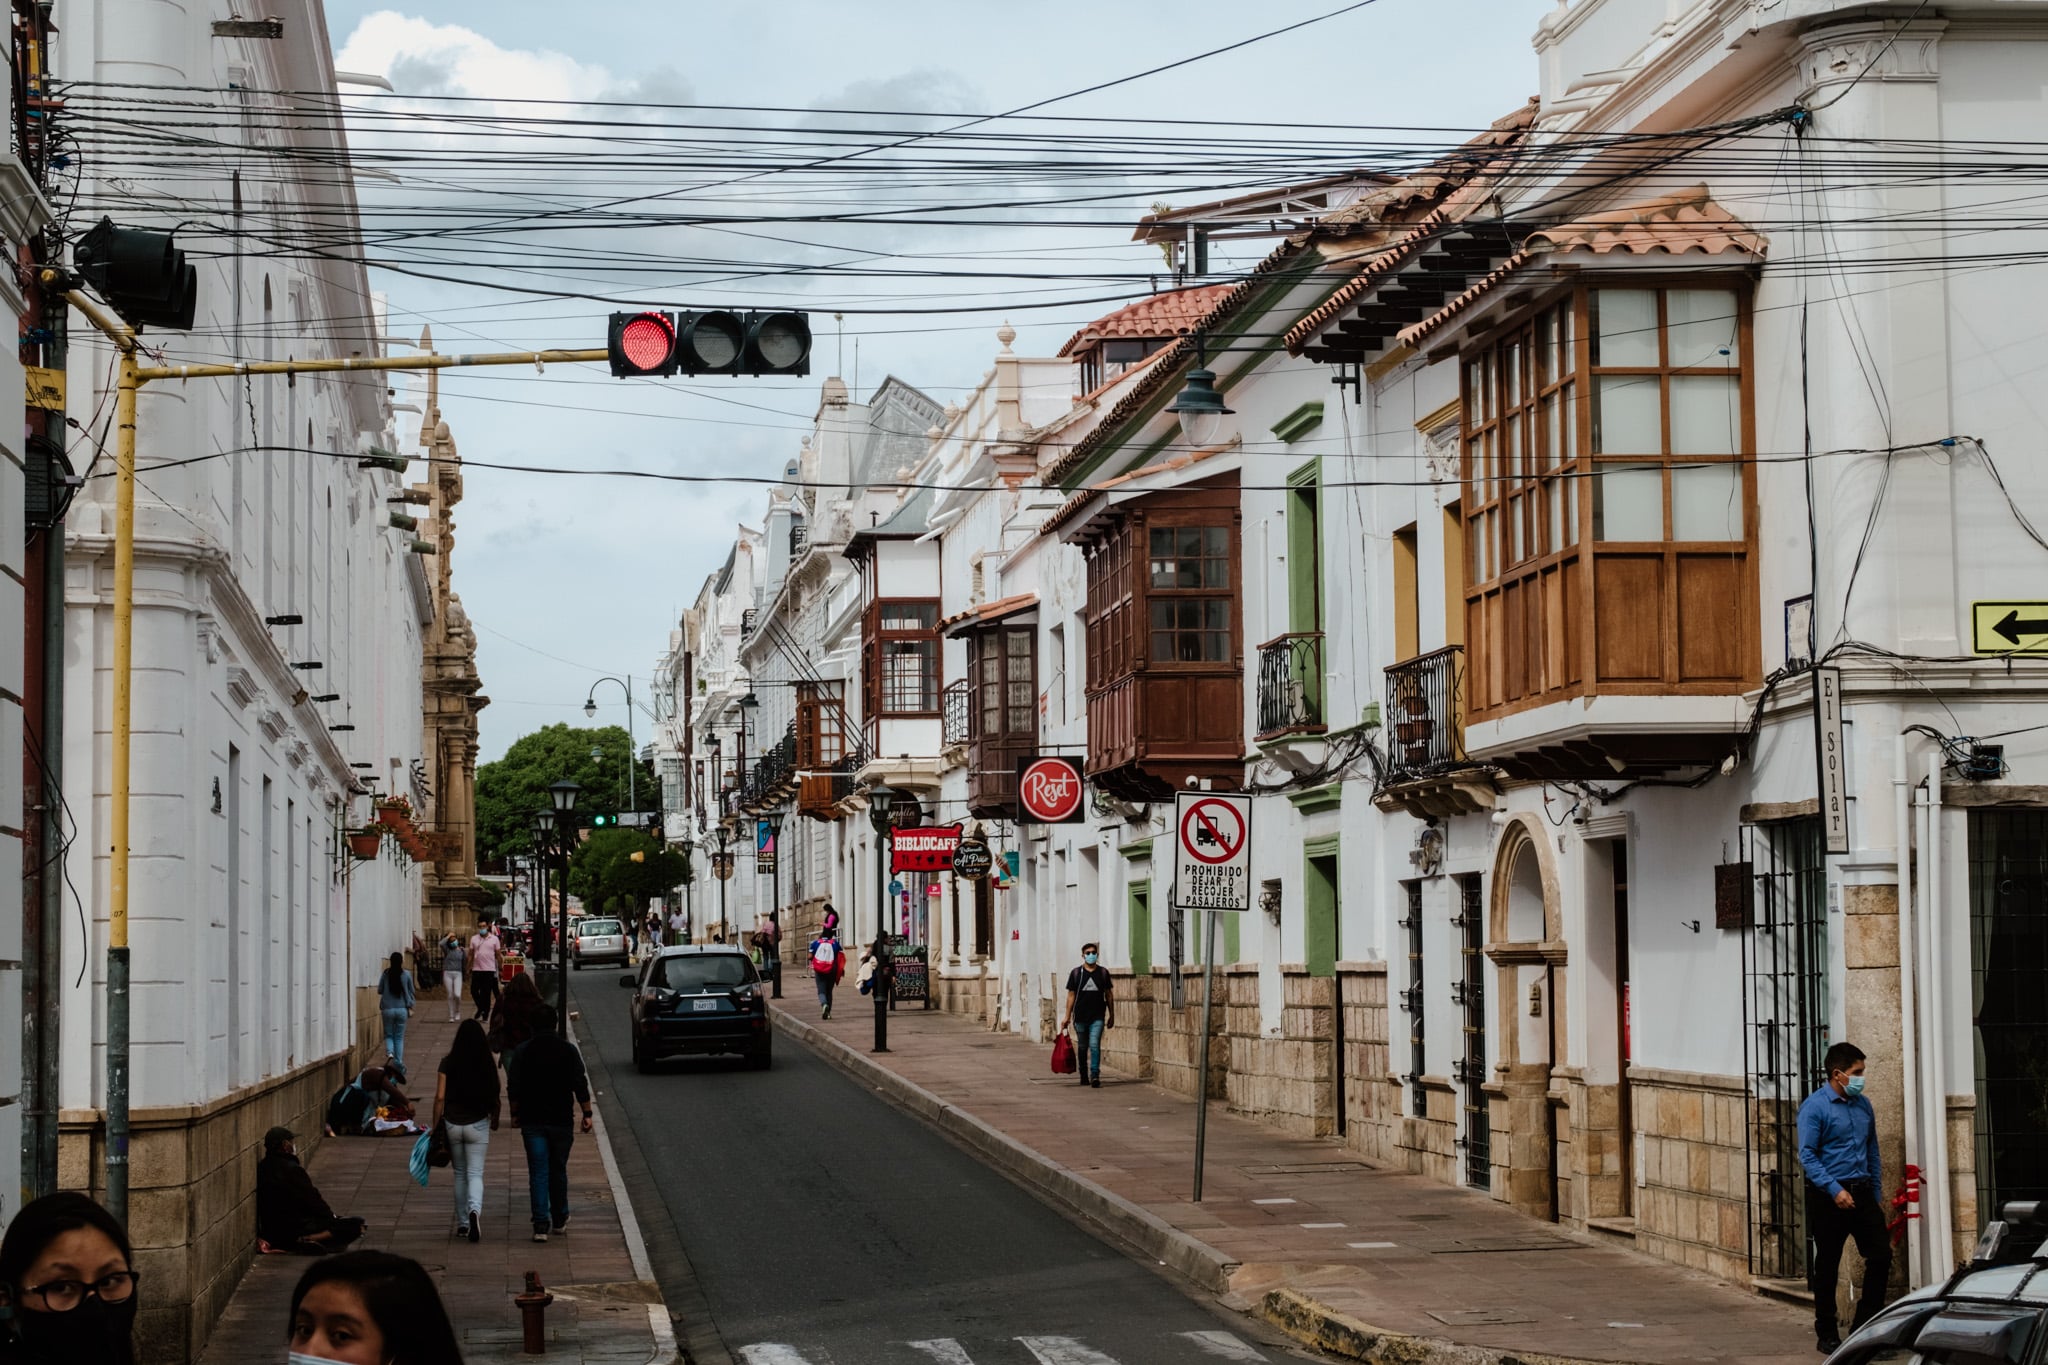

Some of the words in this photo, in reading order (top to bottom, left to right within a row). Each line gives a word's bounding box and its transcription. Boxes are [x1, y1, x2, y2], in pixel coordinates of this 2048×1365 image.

[1824, 677, 1832, 720] El
[1828, 732, 1840, 831] Solar
[1025, 771, 1077, 808] Reset
[894, 836, 959, 851] BIBLIOCAFE
[1185, 864, 1242, 877] PROHIBIDO
[1192, 875, 1222, 887] DEJAR
[1228, 877, 1234, 887] O
[1191, 885, 1234, 897] RECOJER
[1185, 895, 1240, 908] PASAJEROS
[895, 986, 926, 997] PIZZA
